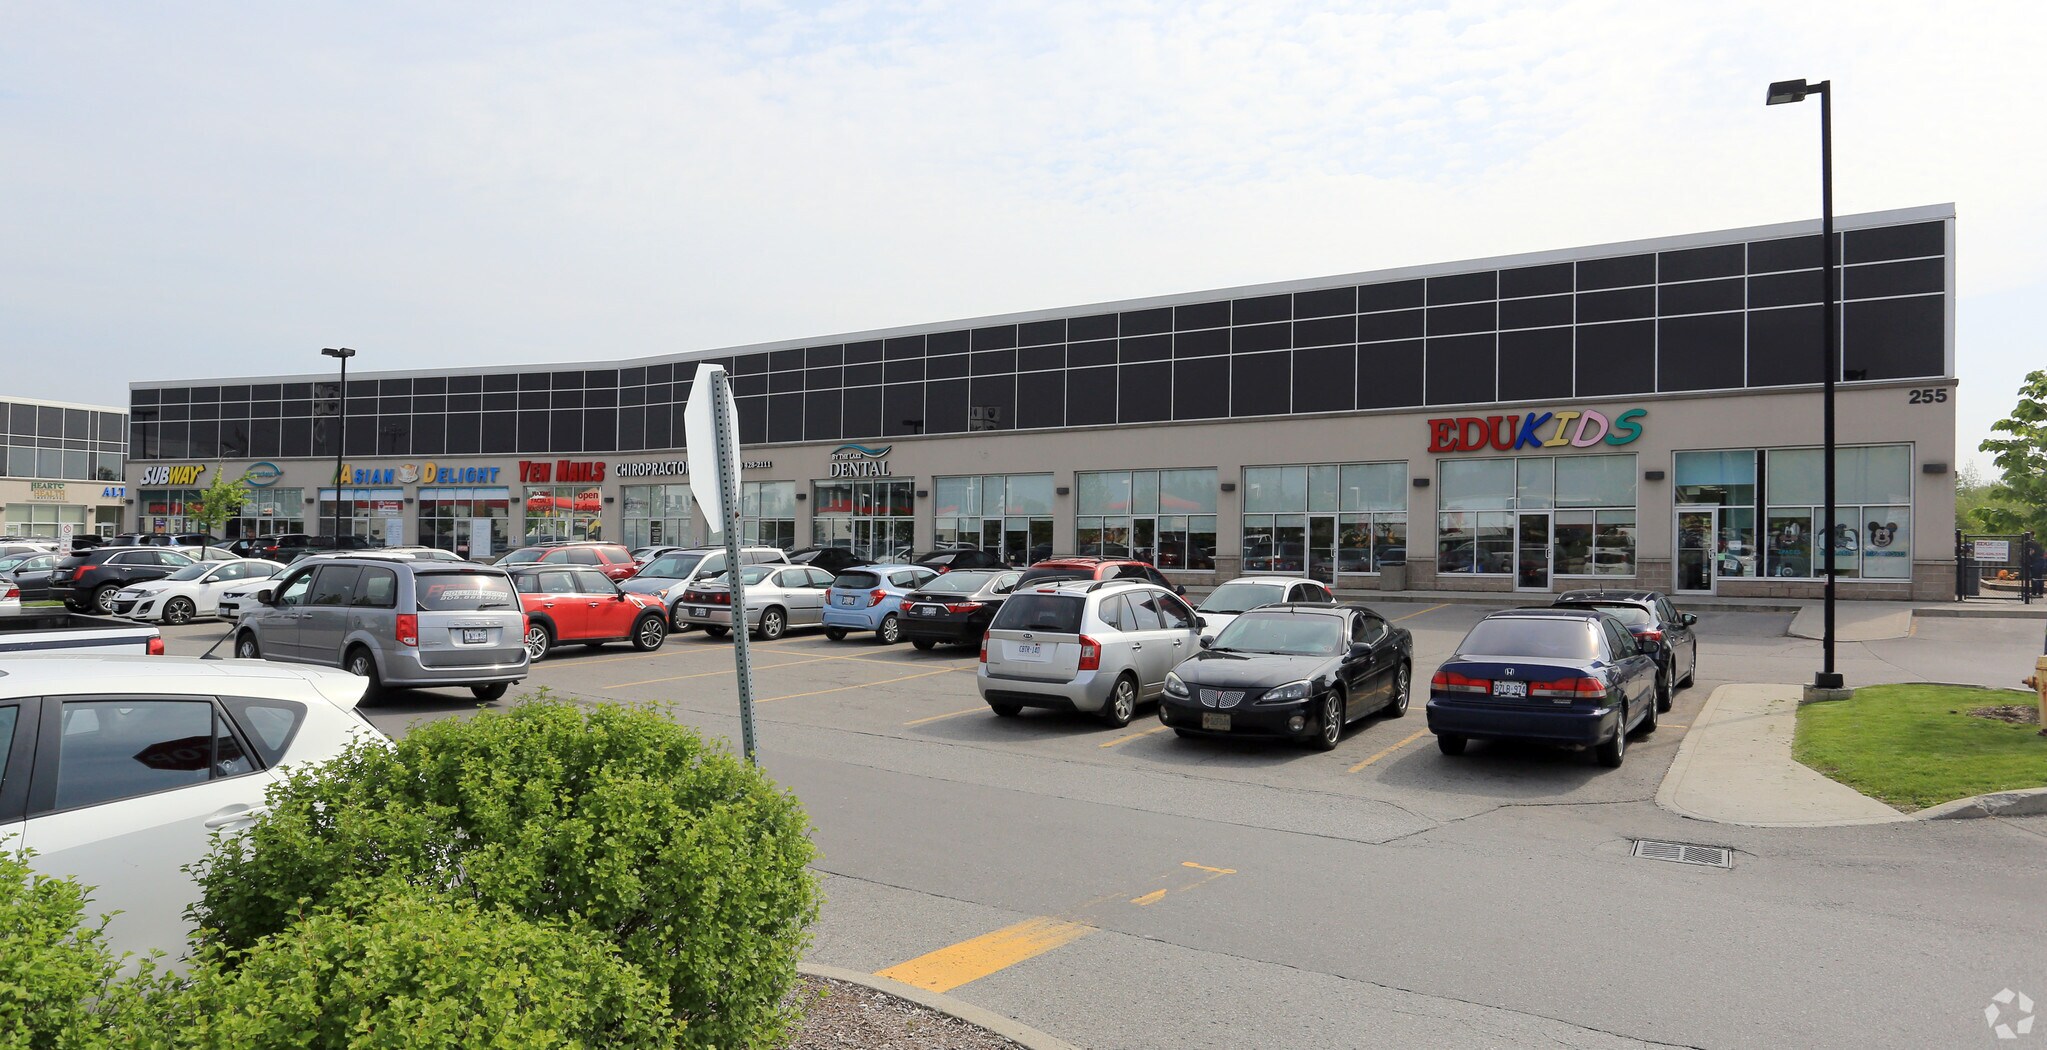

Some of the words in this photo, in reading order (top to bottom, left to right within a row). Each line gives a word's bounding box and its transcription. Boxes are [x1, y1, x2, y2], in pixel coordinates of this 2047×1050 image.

[1909, 388, 1947, 404] 255
[1427, 408, 1648, 453] EDUKIDS
[140, 464, 206, 486] SUBWAY
[332, 463, 395, 485] ASIAN
[423, 461, 500, 484] DELIGHT
[519, 460, 551, 482] YEN
[556, 460, 606, 482] NAILS
[829, 460, 892, 478] DENTAL
[577, 491, 599, 501] open
[582, 502, 602, 513] days
